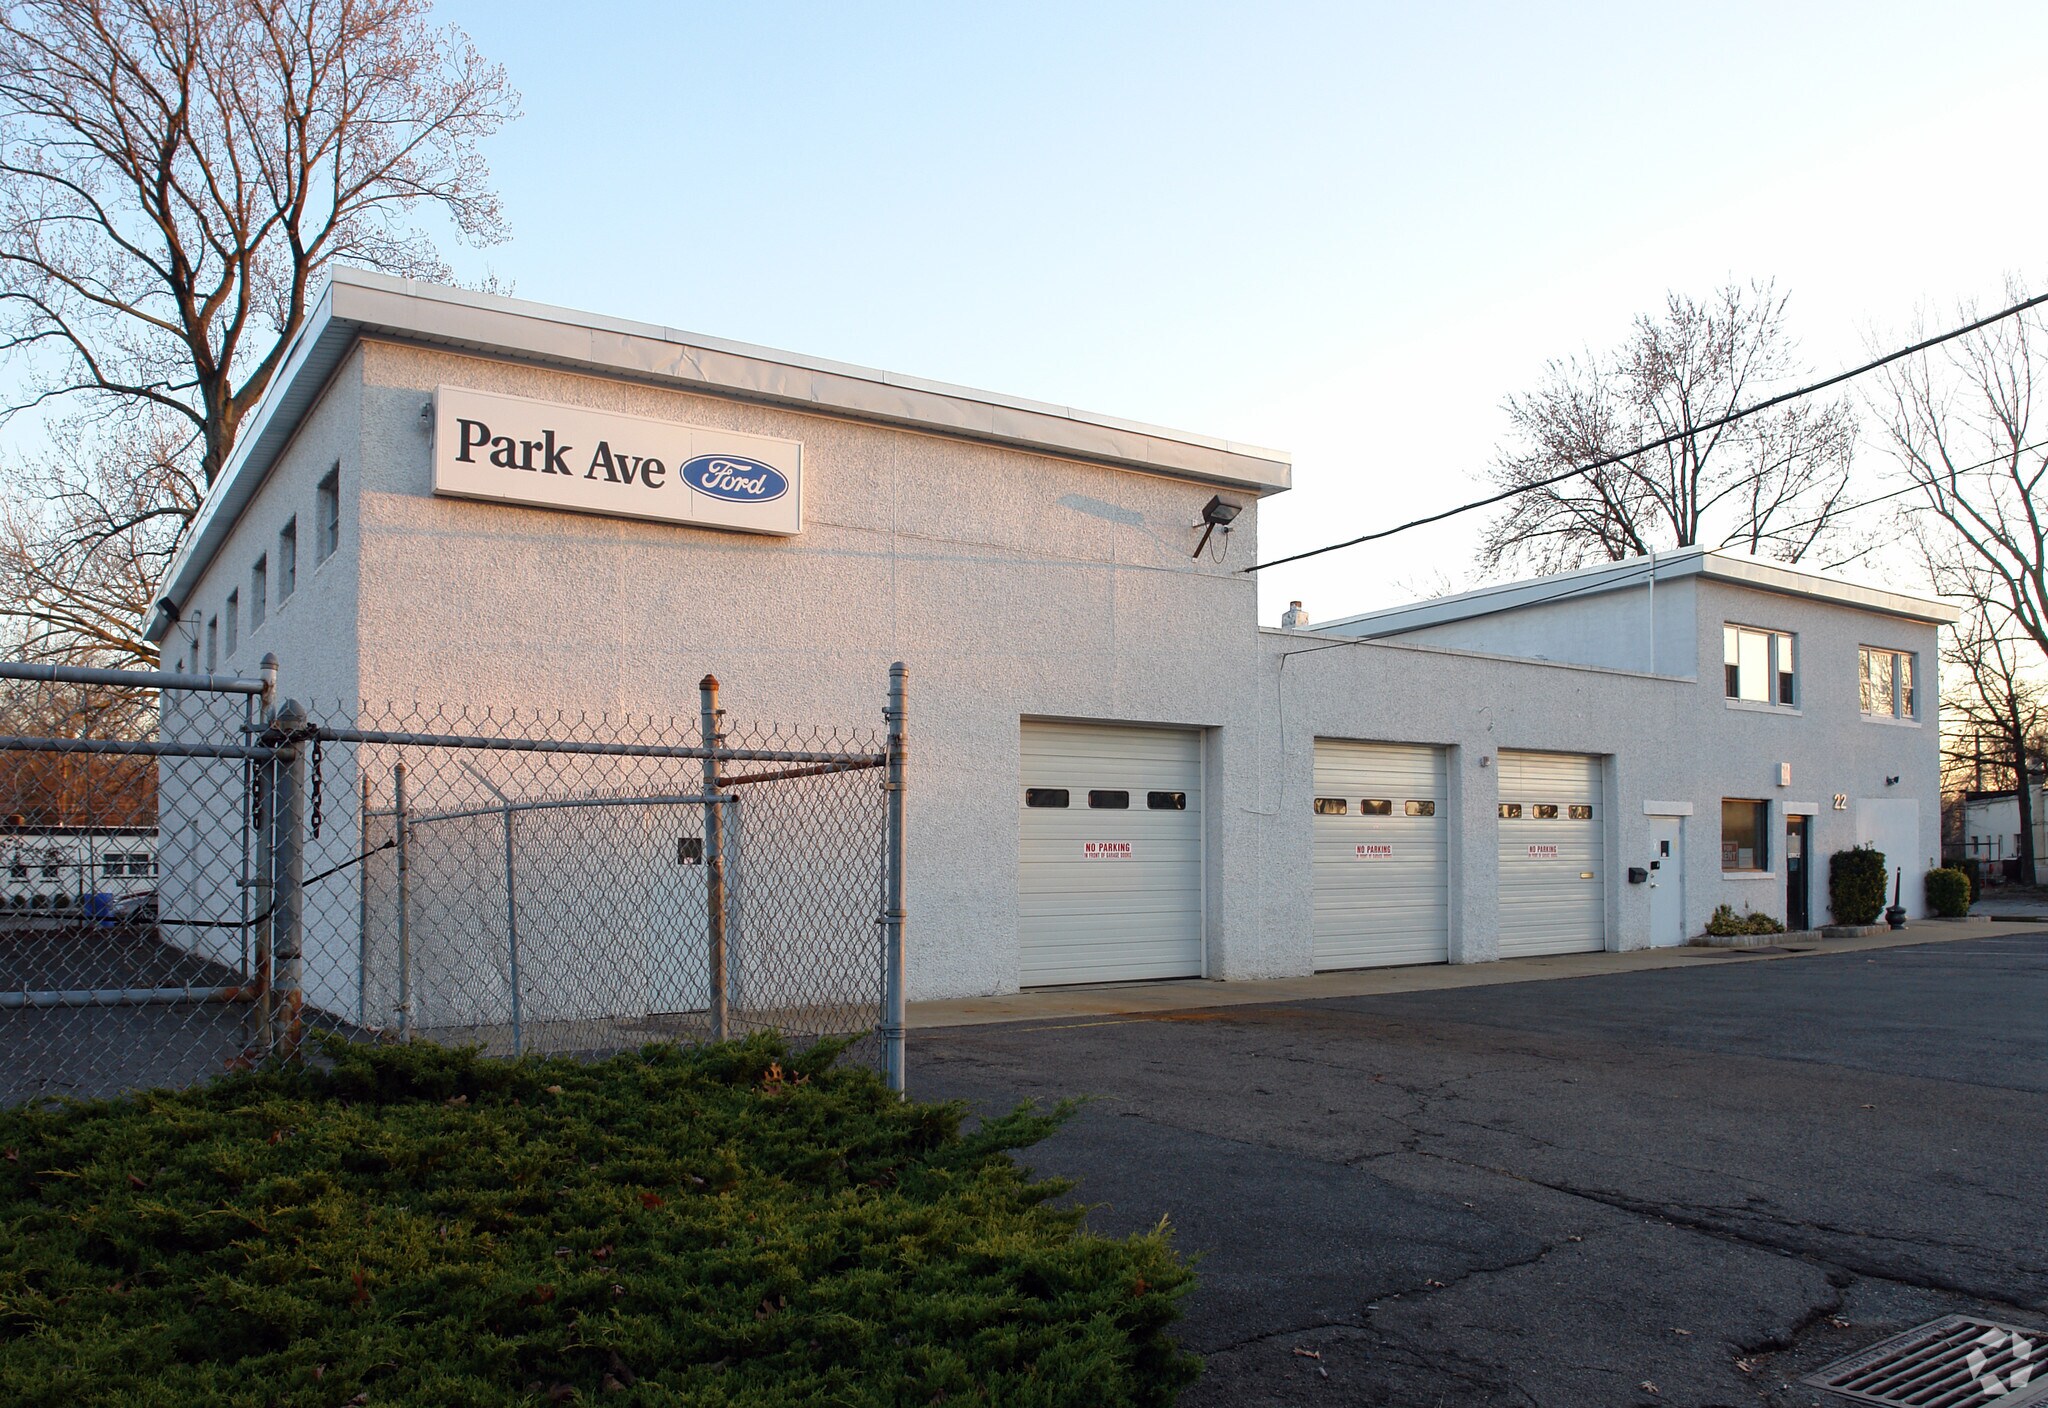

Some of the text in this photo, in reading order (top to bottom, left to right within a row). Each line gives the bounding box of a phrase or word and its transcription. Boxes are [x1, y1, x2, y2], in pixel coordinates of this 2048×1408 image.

[455, 418, 666, 489] Park Ave
[701, 459, 768, 496] Ford
[1833, 793, 1847, 810] 22
[1086, 843, 1130, 852] NO PARKING
